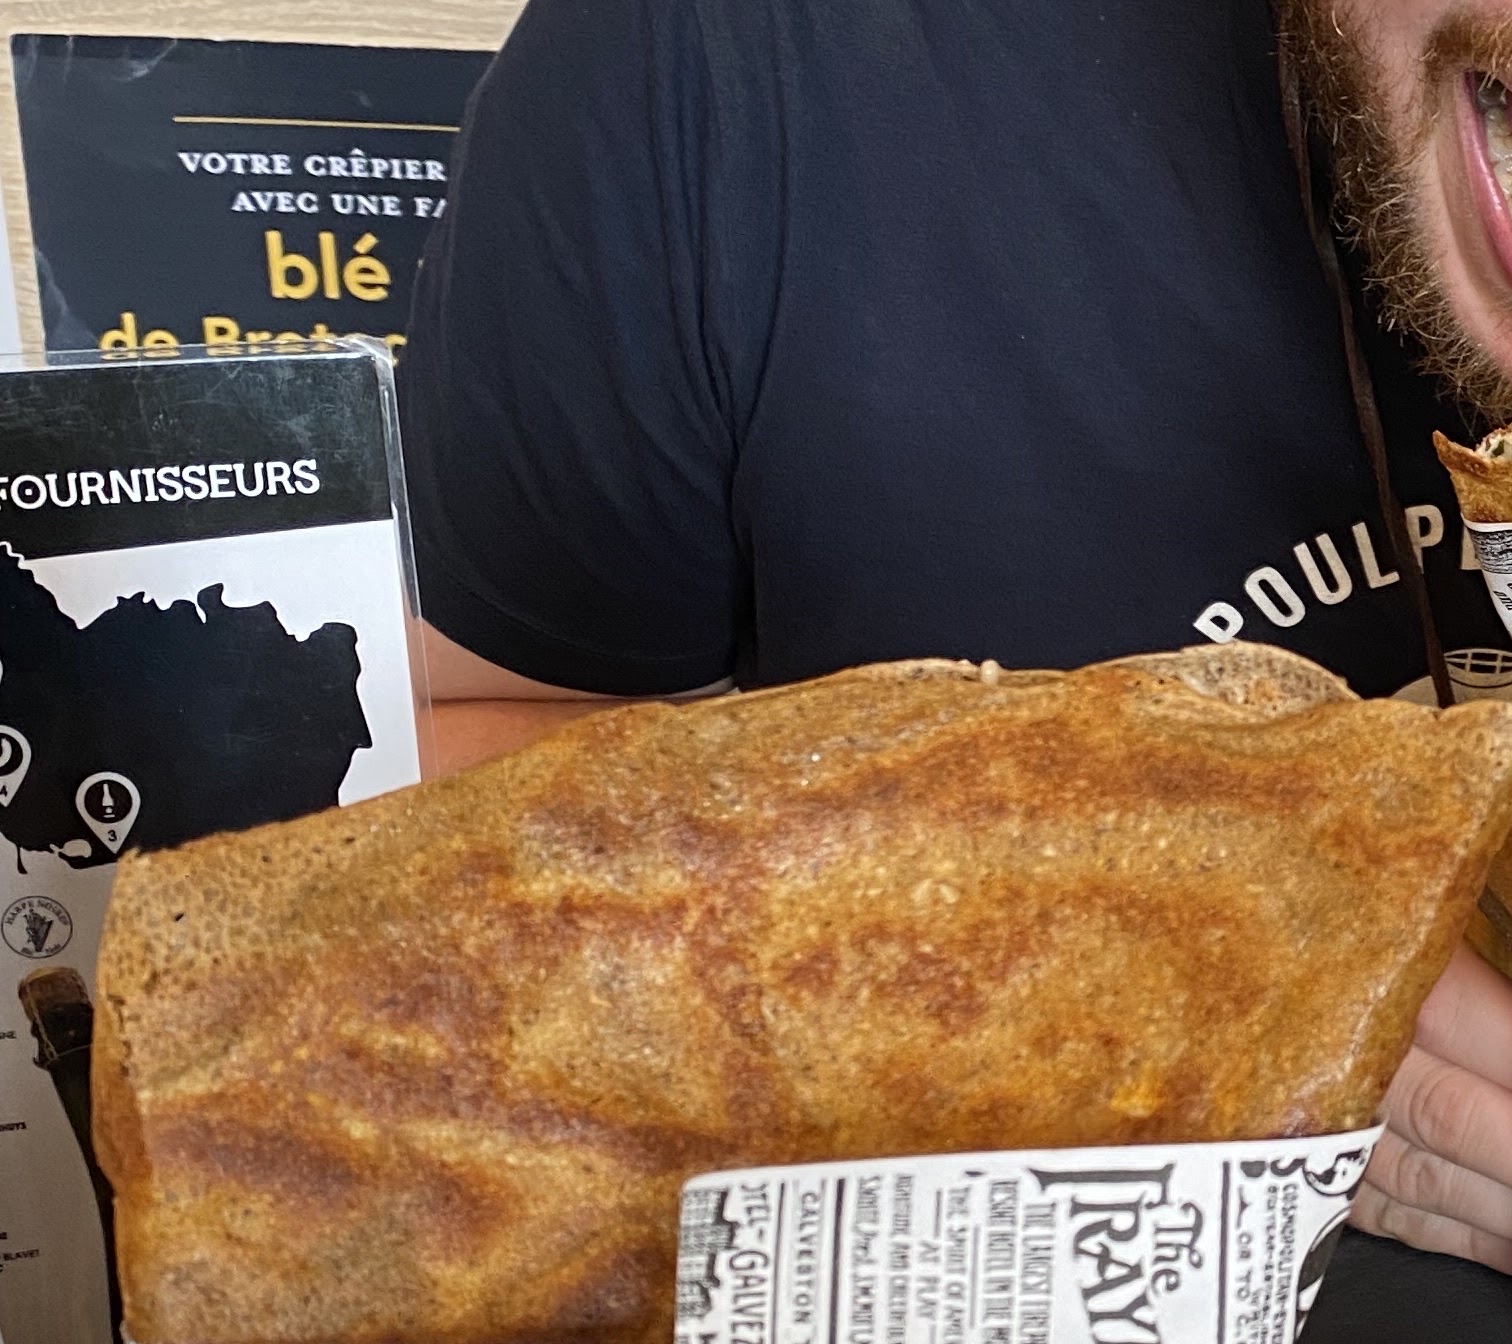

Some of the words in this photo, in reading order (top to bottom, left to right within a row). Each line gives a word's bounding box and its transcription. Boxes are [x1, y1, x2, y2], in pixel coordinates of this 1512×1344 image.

[178, 151, 293, 177] VOTRE
[303, 147, 446, 181] CRÊPIER
[231, 191, 321, 214] AVEC
[330, 193, 403, 216] UNE
[264, 229, 391, 301] blé
[99, 310, 181, 360] de
[1192, 504, 1482, 644] POULP
[107, 829, 118, 842] 3
[793, 1192, 821, 1325] GALVESTON
[1150, 1203, 1204, 1292] The
